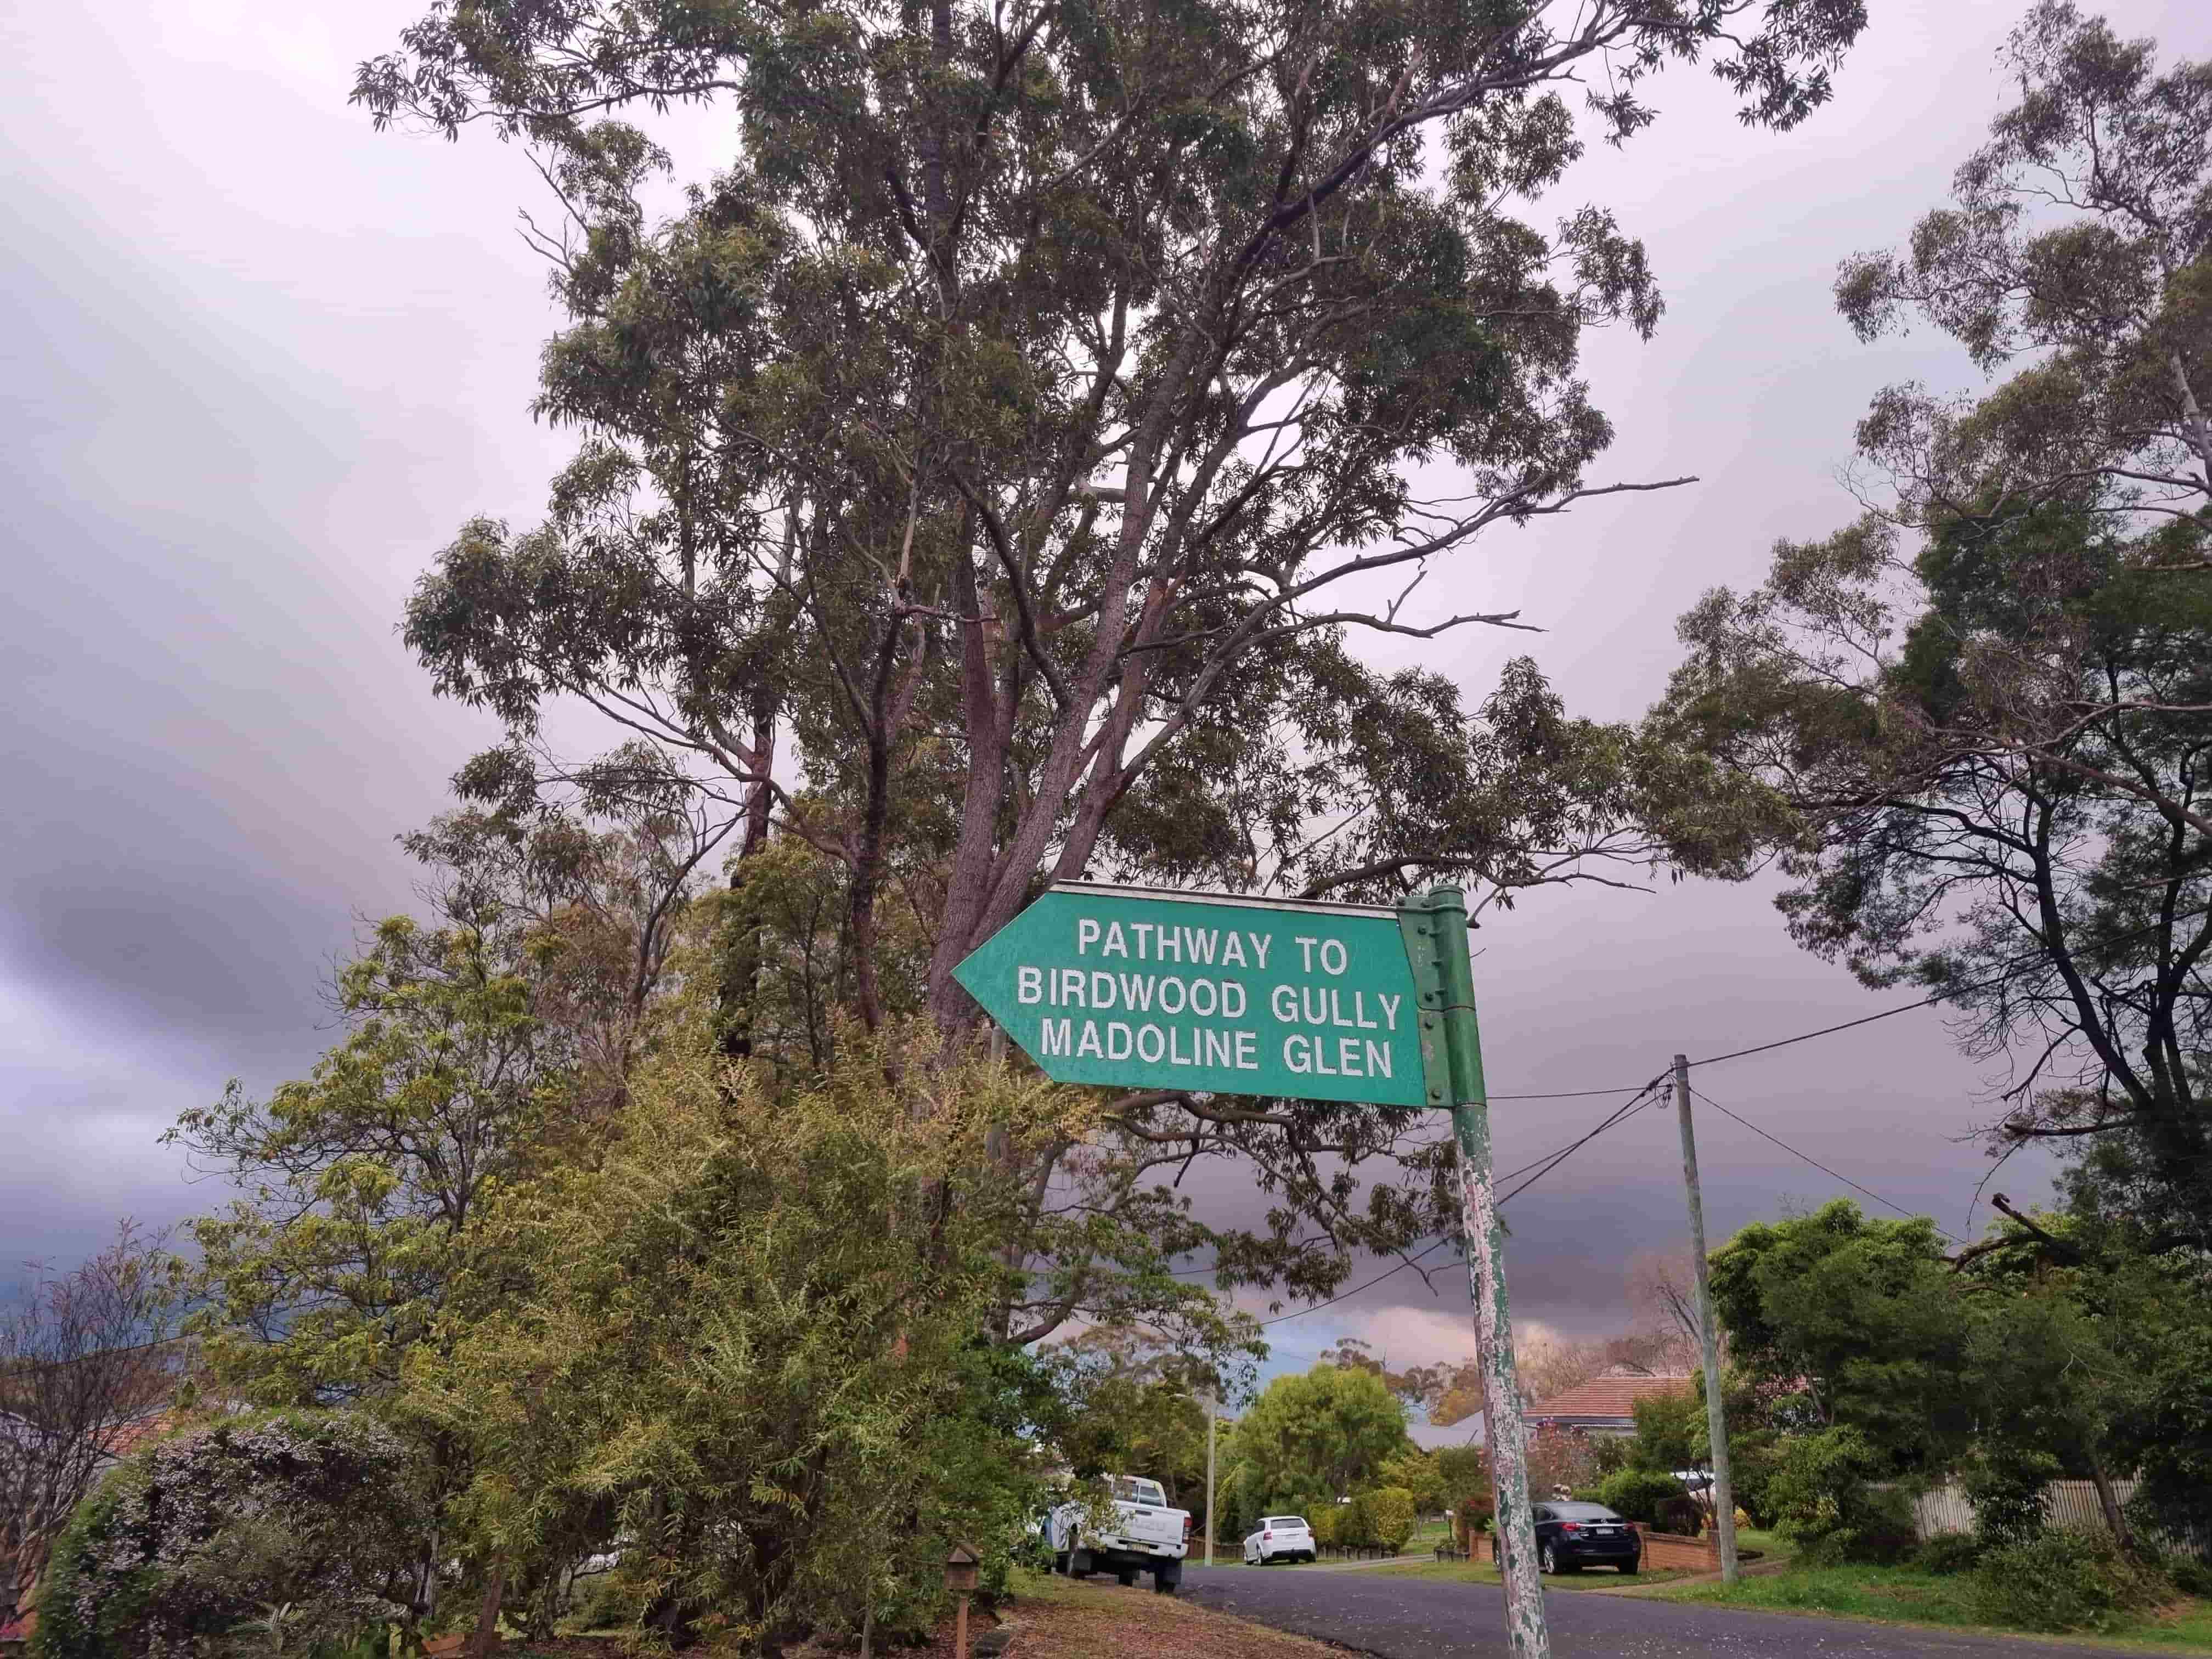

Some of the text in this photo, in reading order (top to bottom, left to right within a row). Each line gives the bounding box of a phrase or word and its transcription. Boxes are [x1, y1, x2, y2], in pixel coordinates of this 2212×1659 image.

[1079, 918, 1347, 975] PATHWAY TO
[1018, 965, 1401, 1030] BIRDWOOD GULLY
[1041, 1018, 1392, 1078] MADOLINE GLEN
